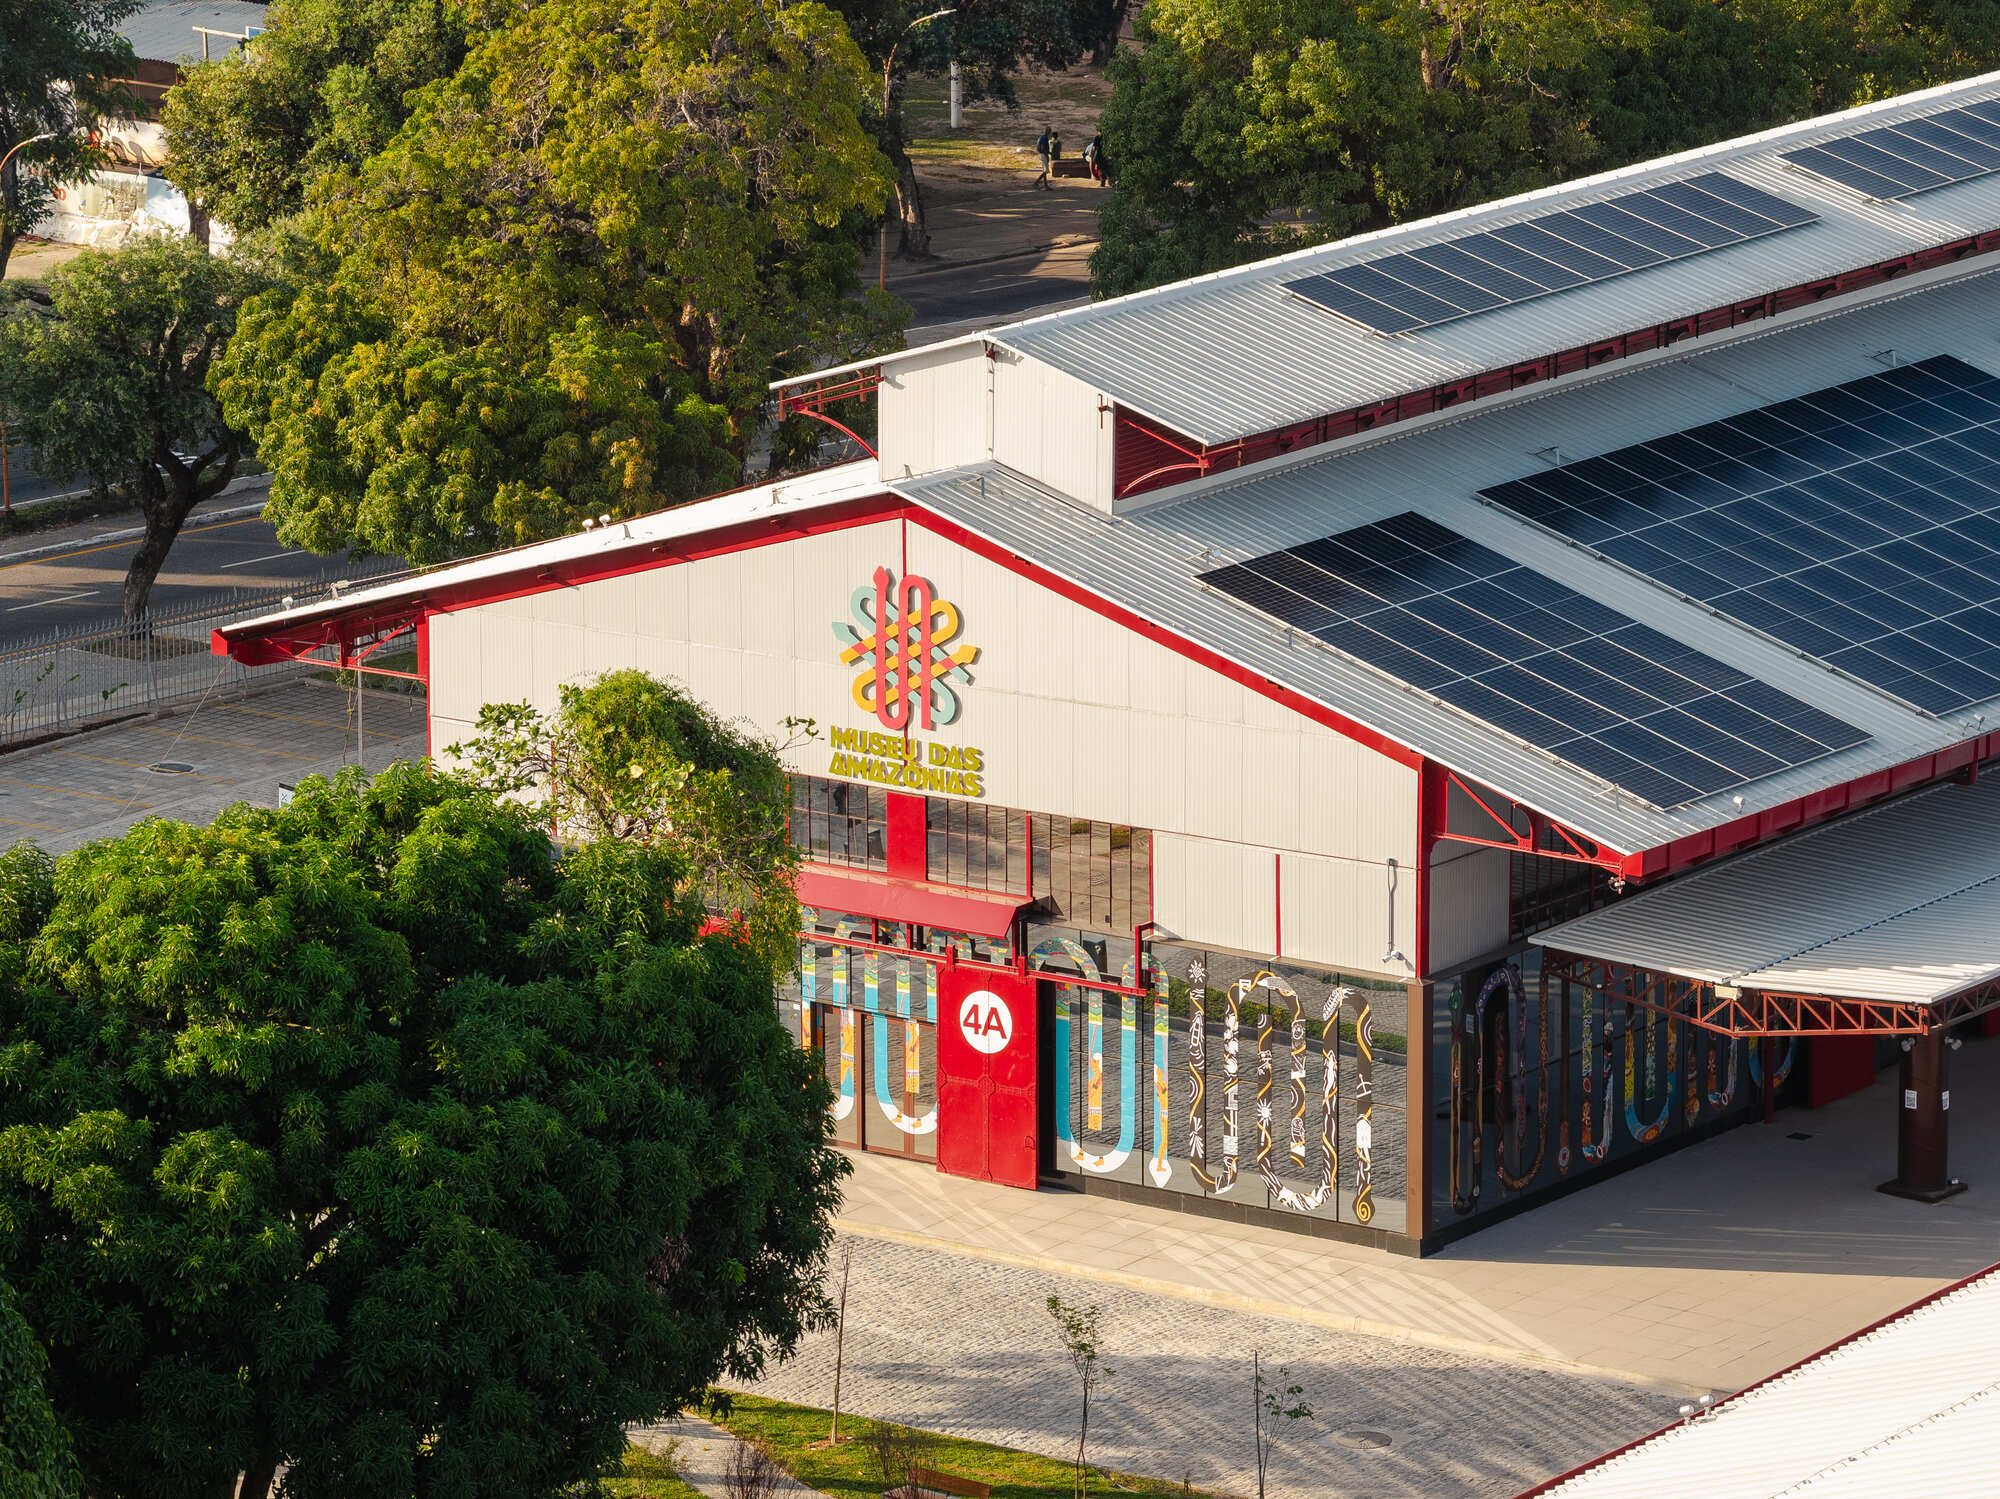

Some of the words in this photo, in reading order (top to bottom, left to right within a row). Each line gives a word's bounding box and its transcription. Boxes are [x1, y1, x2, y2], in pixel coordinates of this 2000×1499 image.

[830, 725, 917, 761] MUSEU
[929, 742, 981, 771] DAS
[963, 1004, 1007, 1039] 4A
